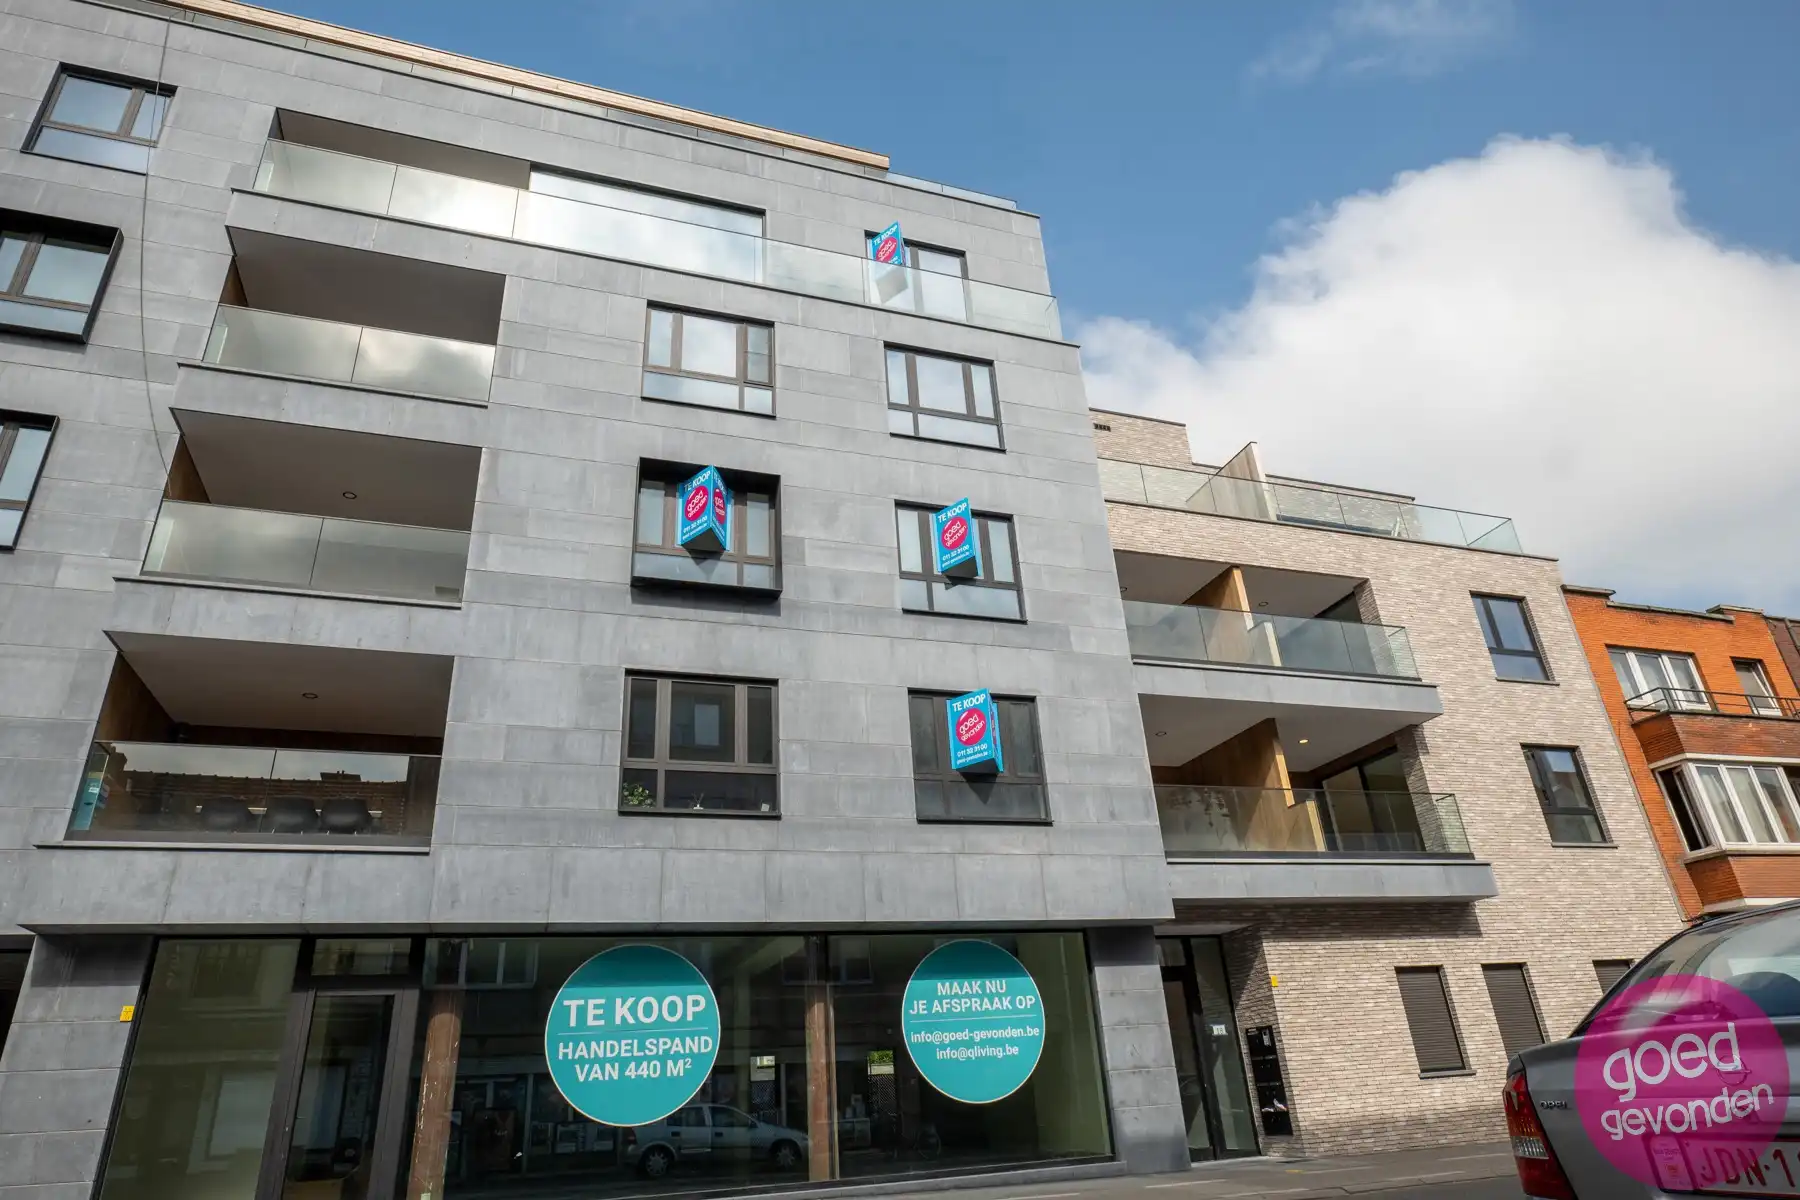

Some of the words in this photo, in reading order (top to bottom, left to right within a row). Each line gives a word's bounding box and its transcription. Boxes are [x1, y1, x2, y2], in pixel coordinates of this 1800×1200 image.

[881, 225, 898, 240] KOOP
[684, 482, 692, 491] TE
[693, 470, 710, 488] KOOP
[687, 490, 704, 512] goed
[938, 513, 947, 522] TE
[947, 502, 967, 517] KOOP
[944, 521, 961, 541] goed
[952, 701, 962, 712] TE
[963, 693, 986, 709] KOOP
[959, 713, 979, 735] goed
[937, 980, 982, 996] MAAK
[985, 979, 1006, 994] NU
[563, 998, 606, 1027] TE
[615, 994, 706, 1025] KOOP
[909, 1000, 928, 1015] JE
[932, 996, 1013, 1013] AFSPRAAK
[1016, 995, 1035, 1009] OP
[911, 1025, 1040, 1044] info@goed-gevonden.be
[558, 1036, 713, 1060] HANDELSPAND
[936, 1044, 1019, 1060] info@qliving.be
[574, 1062, 619, 1083] VAN
[624, 1059, 661, 1080] 440
[666, 1057, 692, 1077] M²
